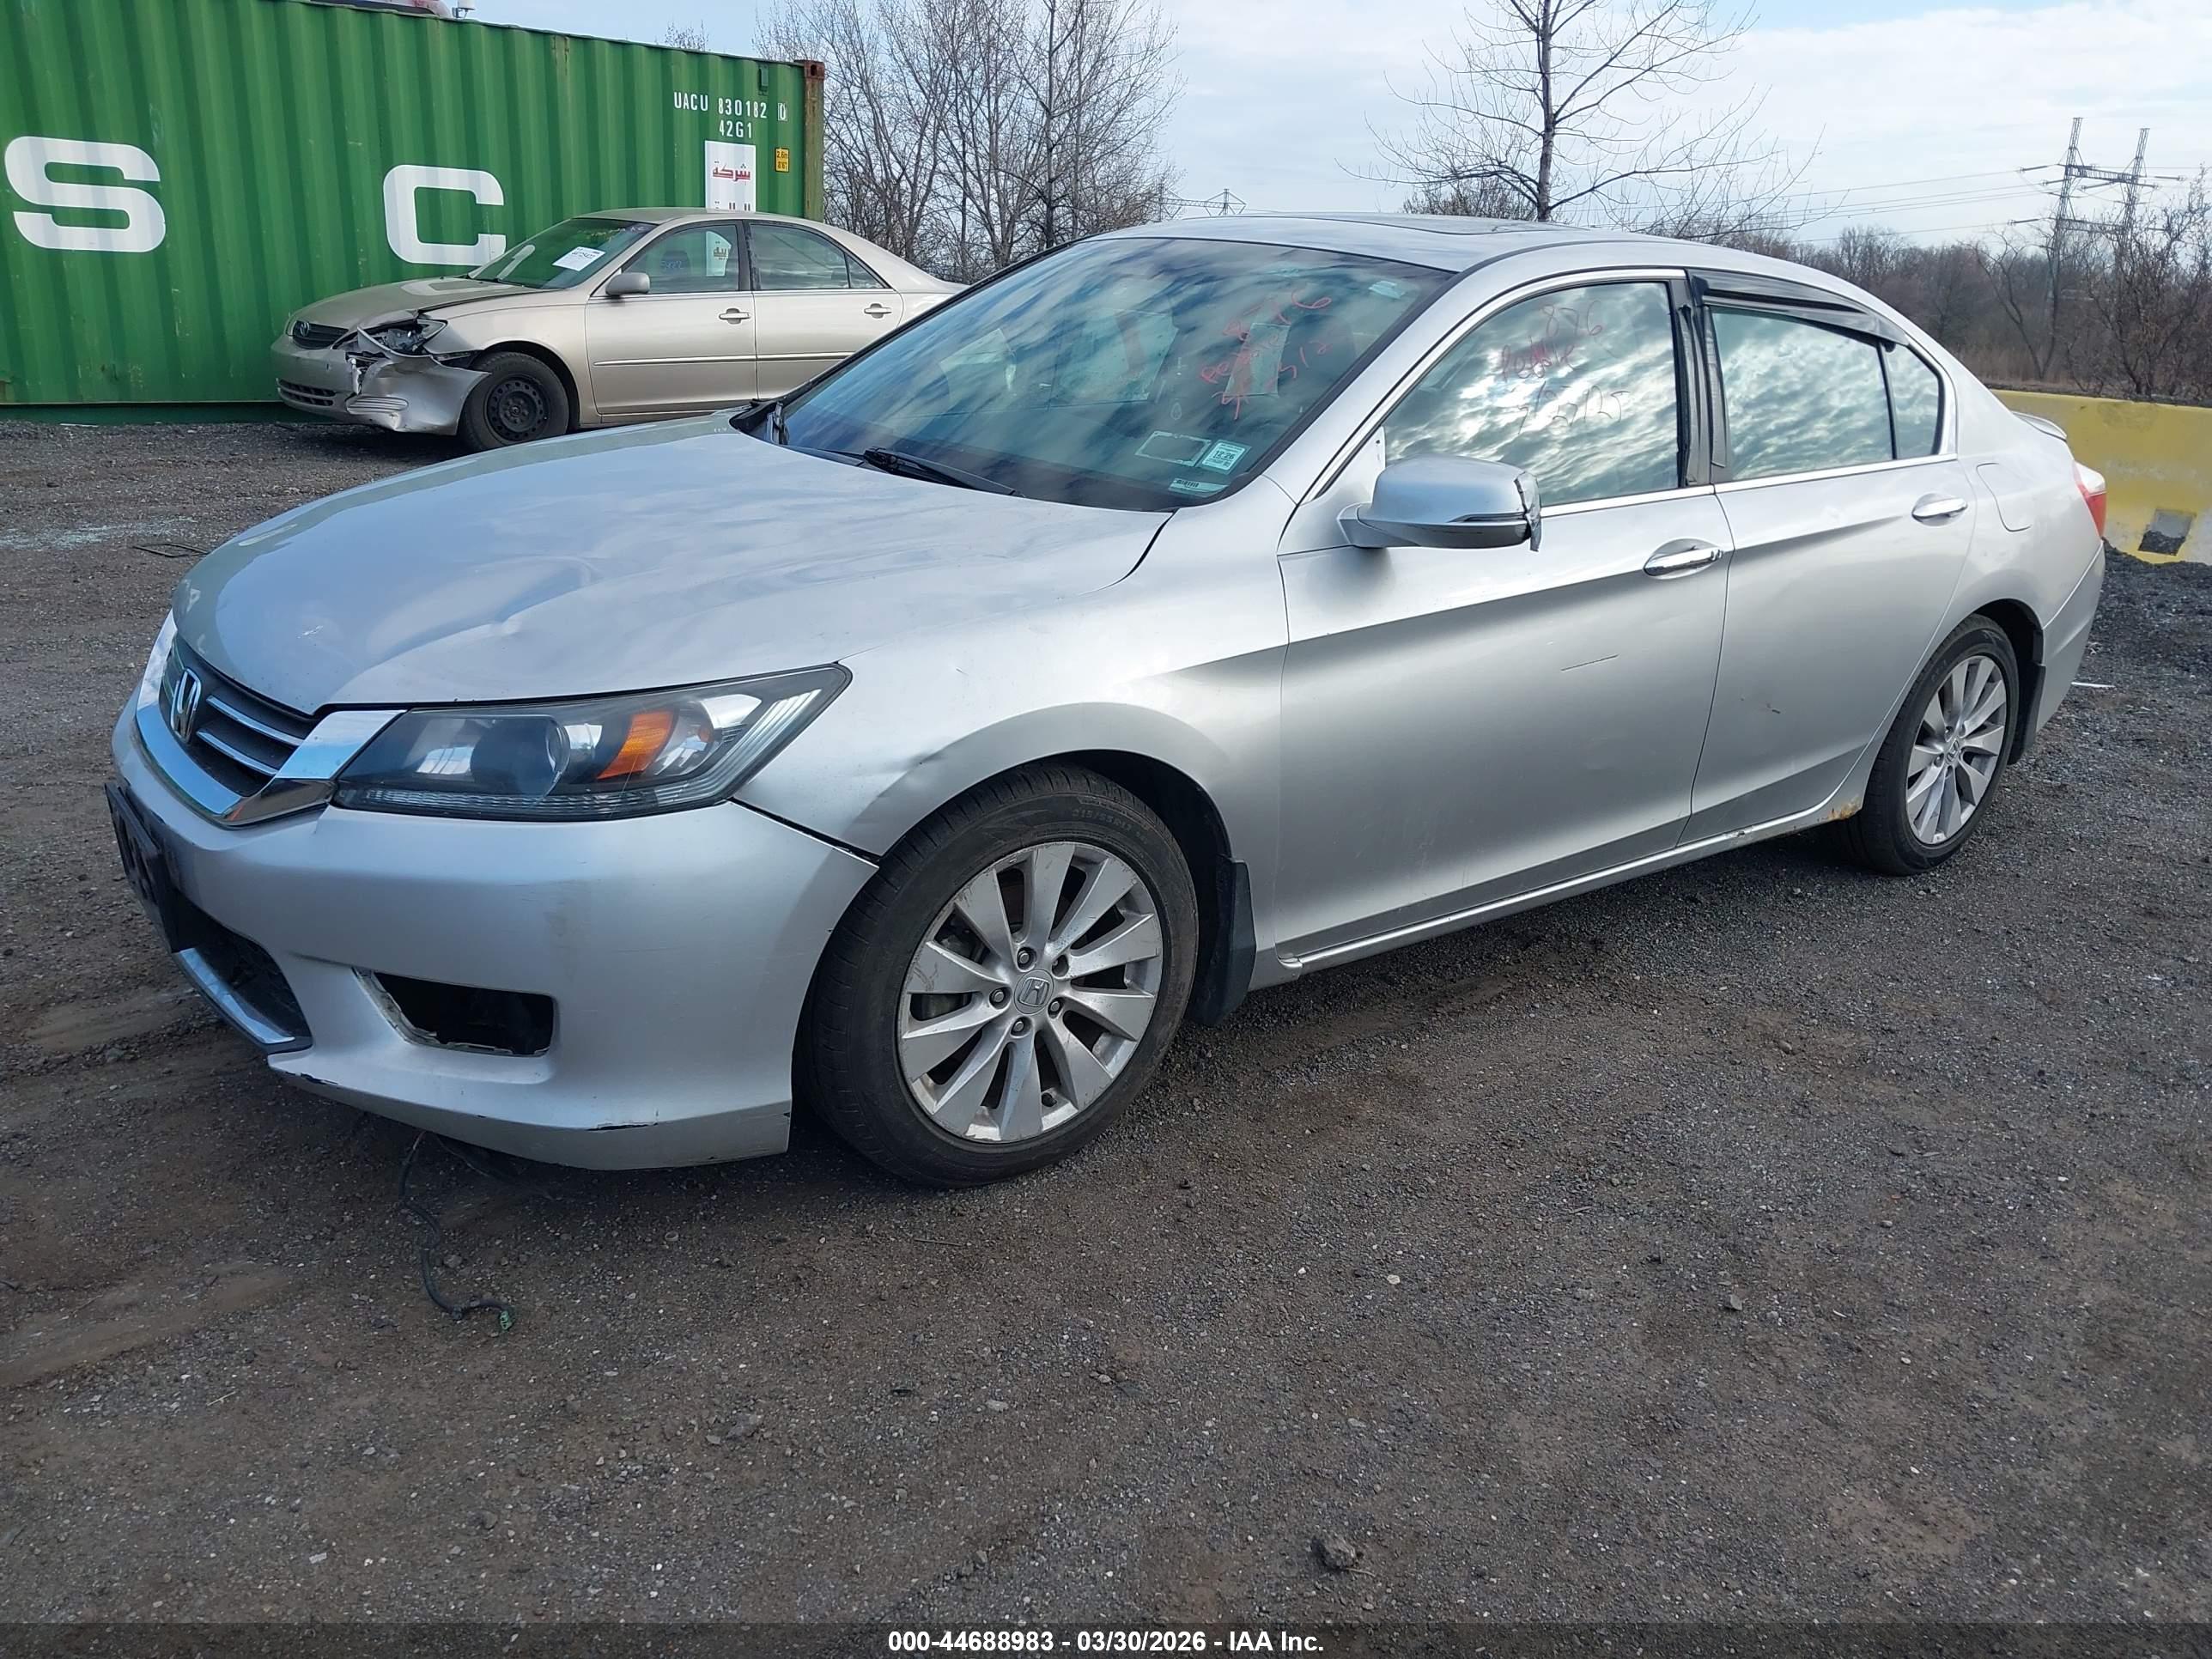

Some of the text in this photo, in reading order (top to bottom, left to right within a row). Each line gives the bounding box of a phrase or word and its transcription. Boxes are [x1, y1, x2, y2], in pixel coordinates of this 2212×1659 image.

[674, 91, 708, 111] UACU
[718, 98, 768, 118] 830182
[719, 118, 752, 138] 42G1
[712, 160, 751, 182] شركة
[4, 136, 507, 266] S C
